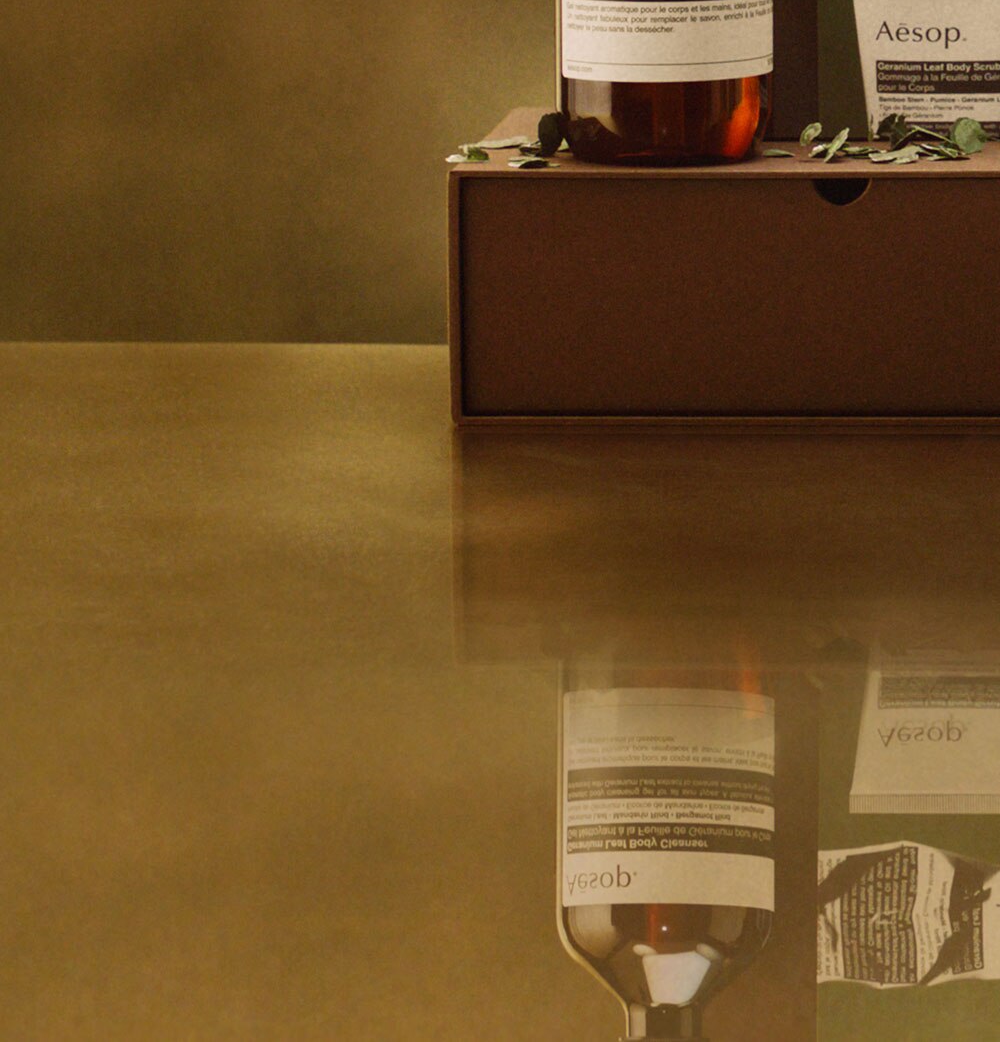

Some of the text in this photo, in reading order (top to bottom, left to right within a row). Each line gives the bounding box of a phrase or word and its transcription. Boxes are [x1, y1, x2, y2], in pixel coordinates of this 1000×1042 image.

[640, 6, 658, 14] pour
[660, 5, 666, 13] le
[668, 5, 690, 14] corps
[691, 4, 699, 12] et
[700, 4, 710, 12] les
[630, 17, 648, 25] pour
[650, 16, 688, 25] remplacer
[690, 15, 698, 23] le
[877, 62, 922, 71] Geranium
[923, 62, 945, 72] Leaf
[946, 62, 972, 73] Body
[877, 72, 921, 82] Gommage
[922, 72, 930, 81] à
[930, 72, 939, 81] la
[940, 73, 970, 82] Feuille
[970, 72, 983, 81] de
[877, 82, 936, 93] pour le Corps
